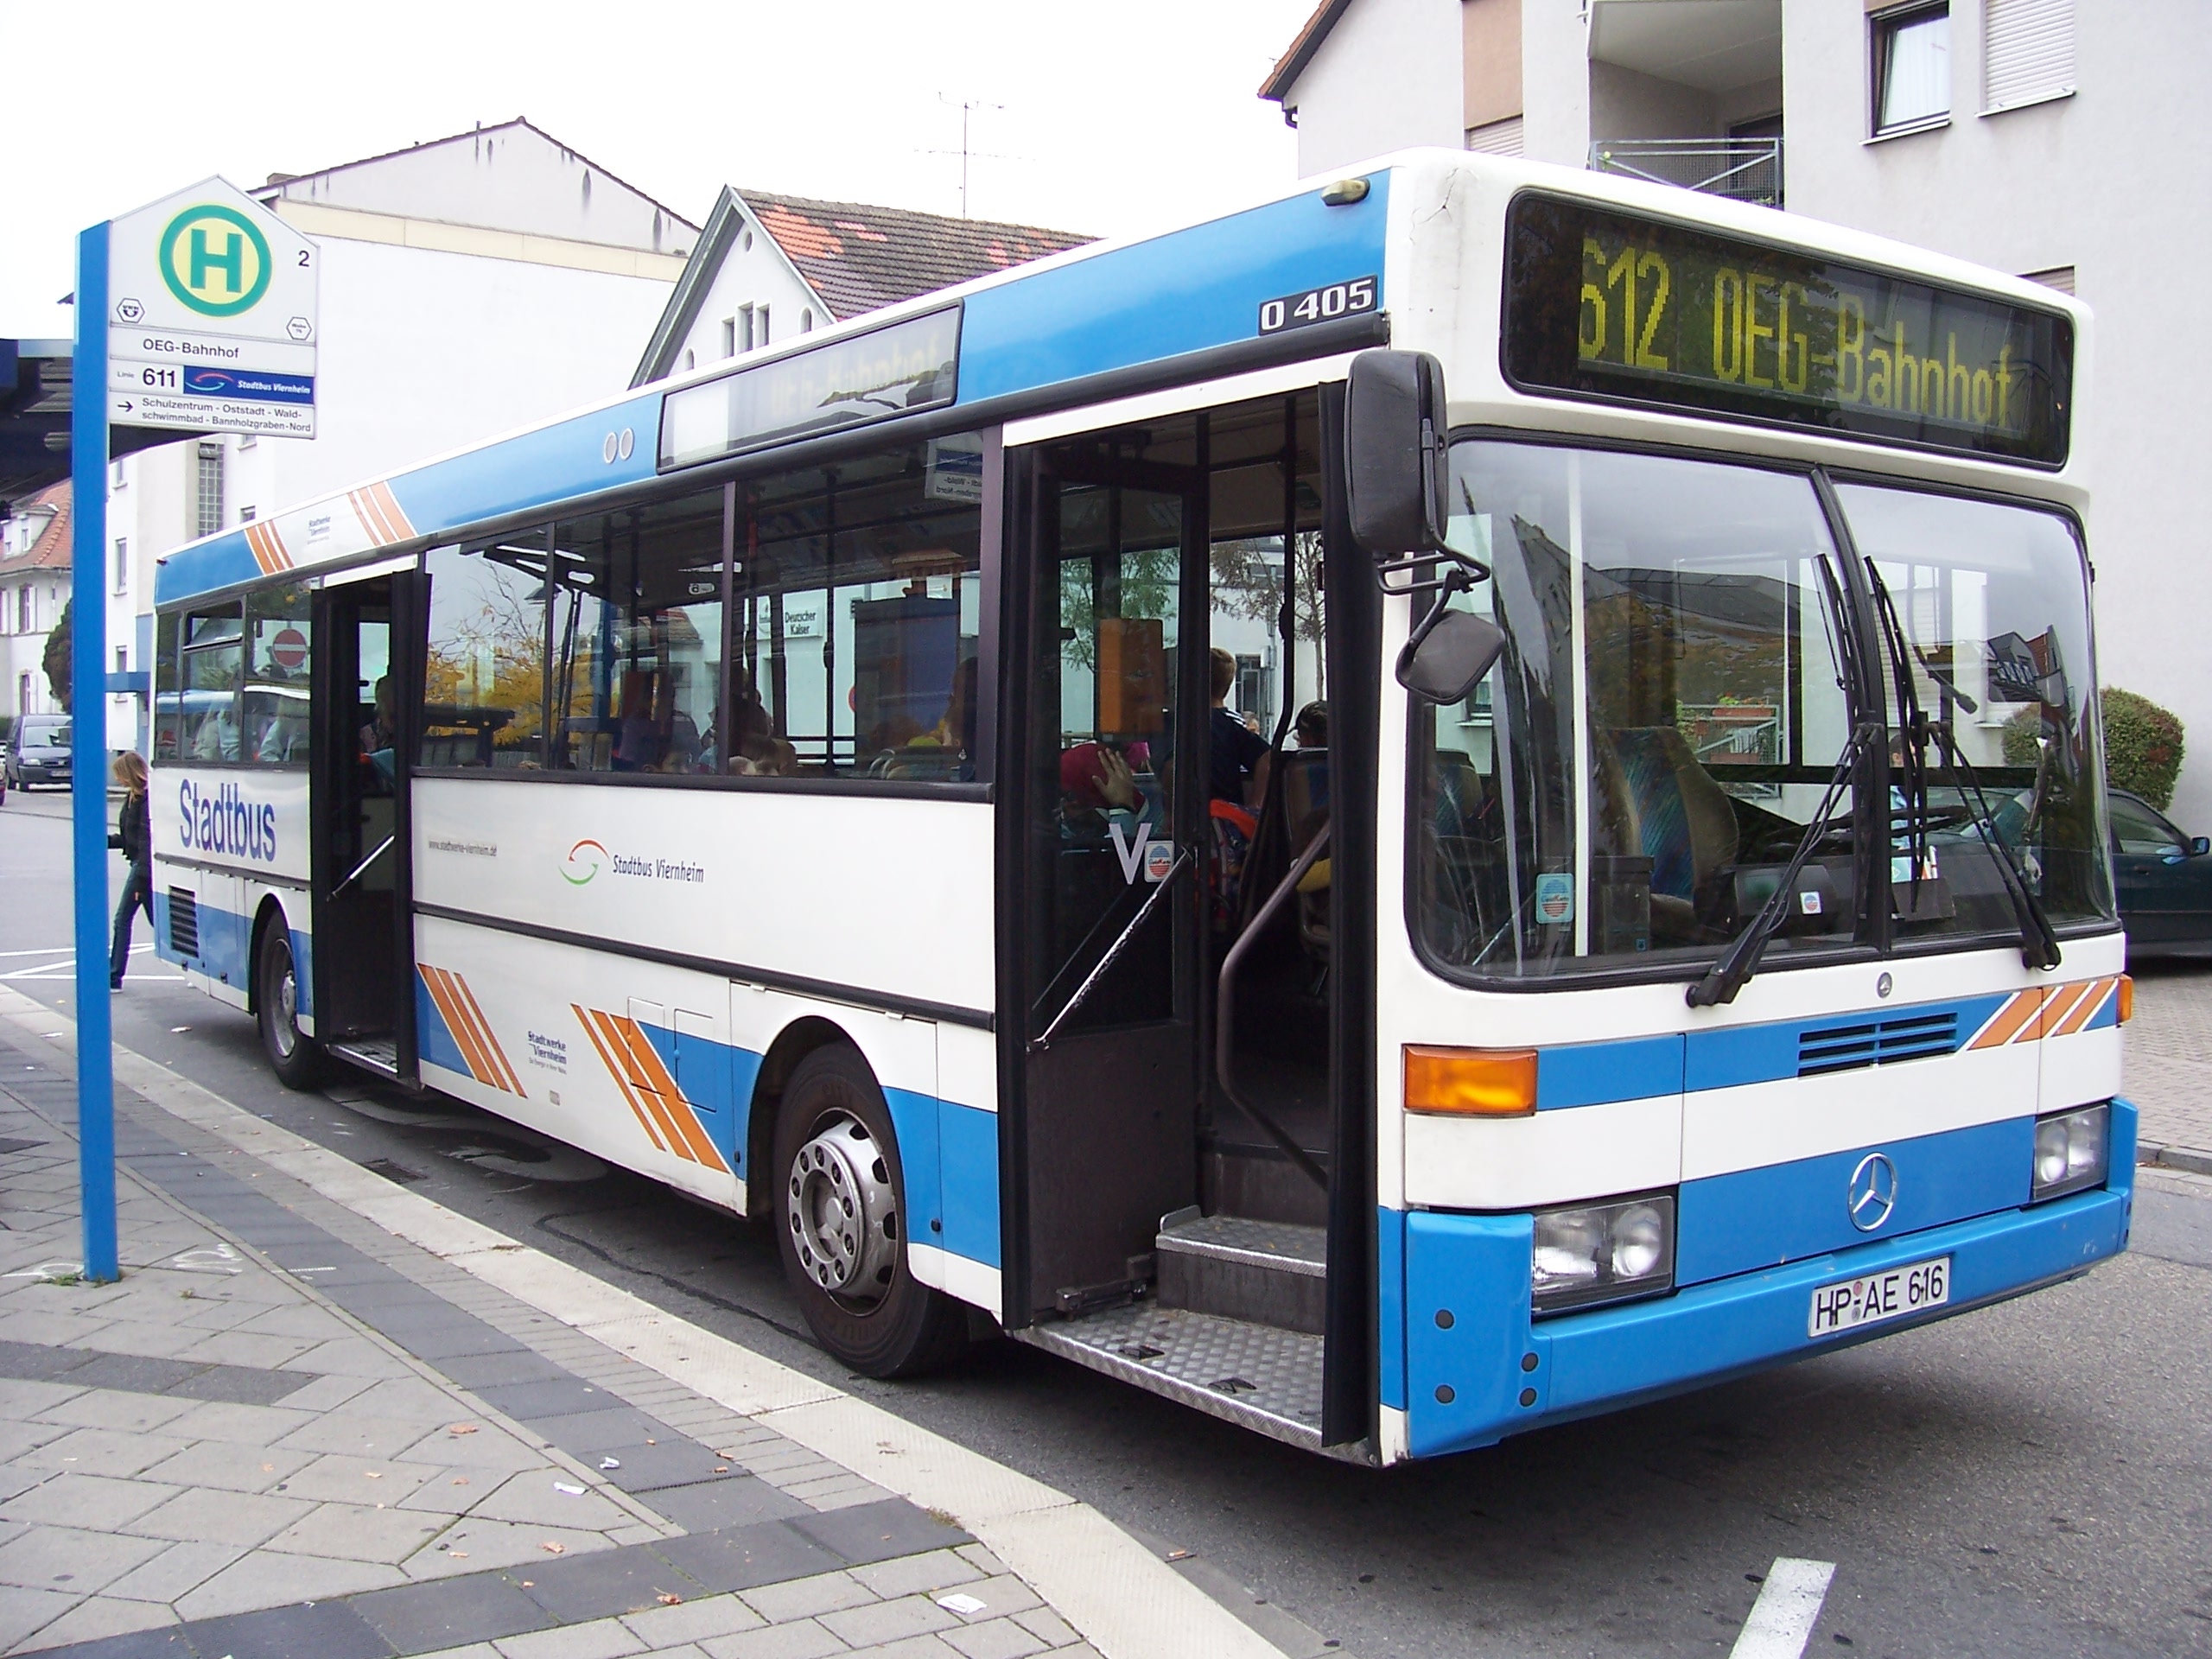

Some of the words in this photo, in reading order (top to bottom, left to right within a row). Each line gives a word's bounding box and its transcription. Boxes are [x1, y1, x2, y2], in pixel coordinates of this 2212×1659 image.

[189, 228, 243, 293] H
[298, 250, 310, 267] 2
[1294, 279, 1373, 320] 405
[1578, 238, 1670, 372] 612
[1713, 266, 2015, 429] OEG-Bahnhof
[143, 338, 239, 359] OEG-Bahnhof
[143, 367, 175, 388] 611
[237, 380, 272, 391] Stadtbus
[273, 383, 311, 395] Viernheim
[142, 397, 213, 412] Schulzentrum
[222, 404, 265, 416] Oststadt
[274, 408, 302, 418] Wald-
[142, 411, 204, 424] schwimmbad
[212, 415, 312, 433] Bannholzgraben-Nord
[785, 610, 817, 623] Deutscher
[180, 778, 276, 862] Stadtbus
[1109, 823, 1153, 885] V
[613, 855, 652, 877] Stadtbus
[656, 859, 704, 883] Viernheim
[528, 1031, 567, 1052] Stadtwerke
[528, 1043, 567, 1065] Viernheim
[1908, 1264, 1943, 1305] 616
